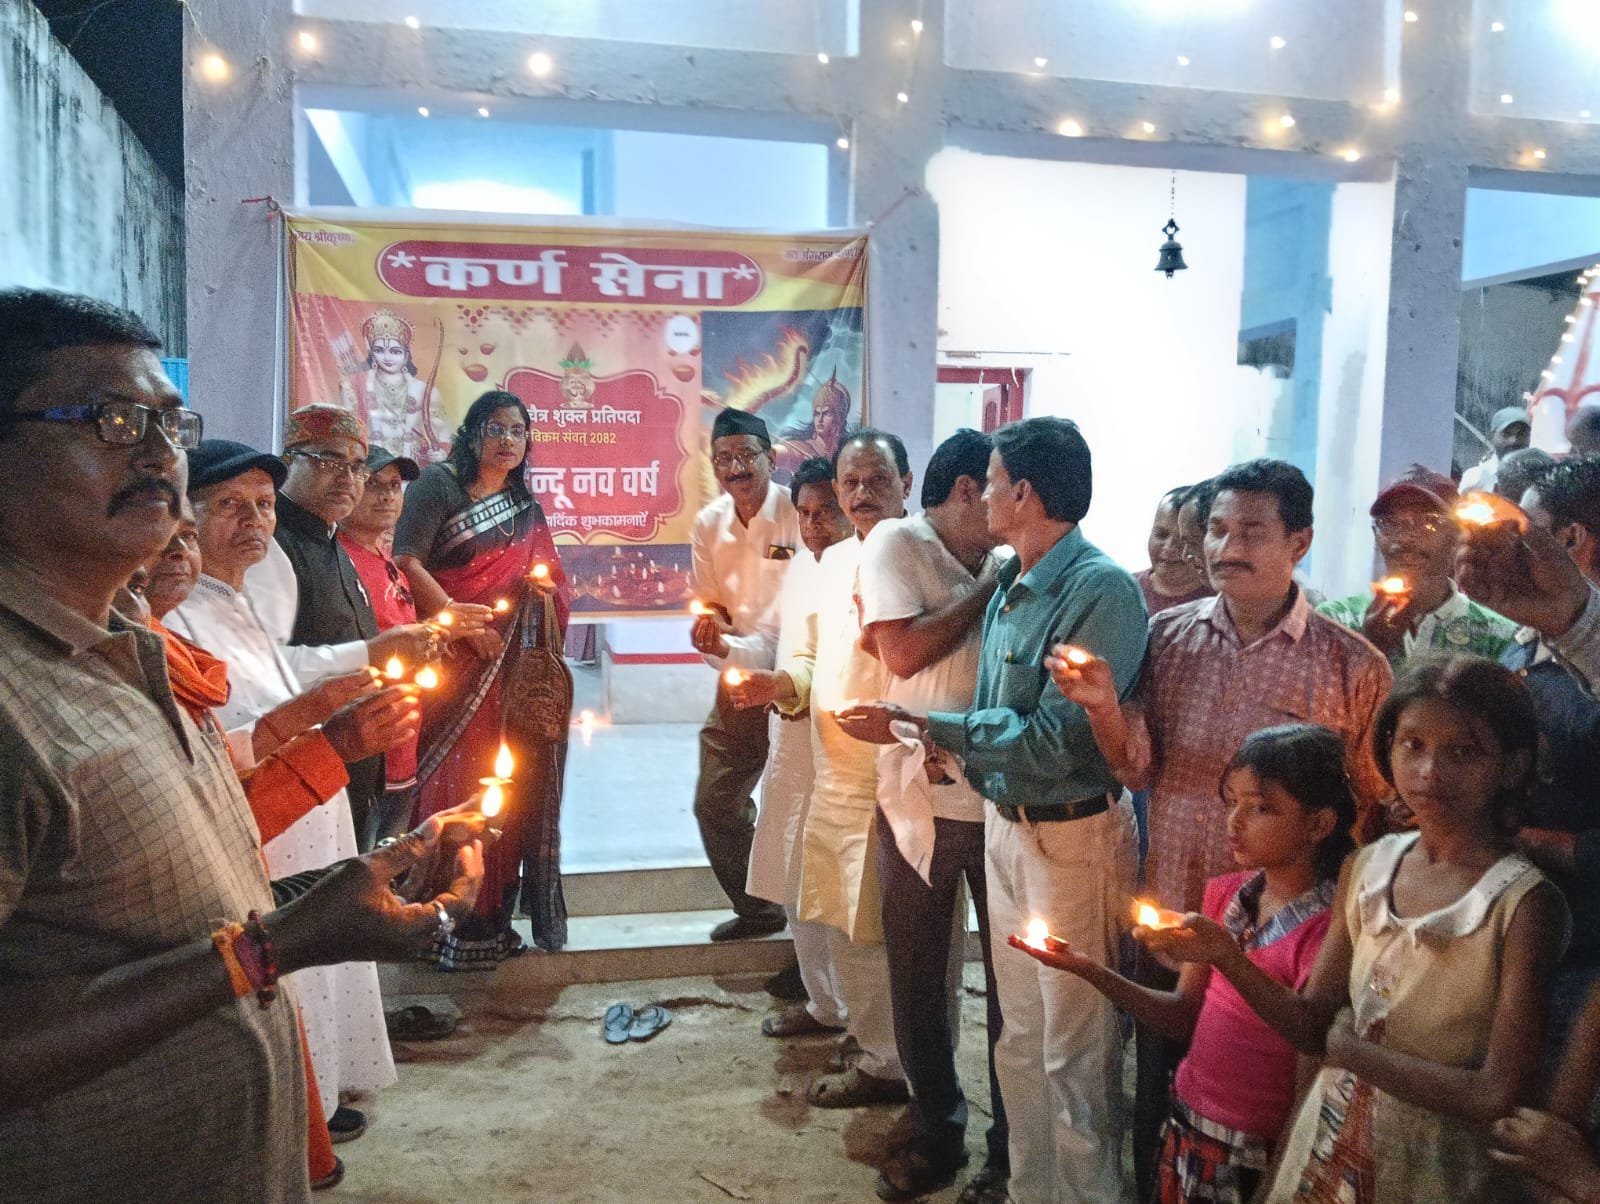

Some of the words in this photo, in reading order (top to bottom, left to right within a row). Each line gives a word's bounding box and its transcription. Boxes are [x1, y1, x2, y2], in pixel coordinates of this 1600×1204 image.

[553, 408, 588, 427] शुक्ल
[591, 405, 641, 424] प्रतिपदा
[531, 429, 560, 443] विक्रम
[589, 432, 617, 444] 2082
[571, 467, 617, 497] नव
[620, 460, 660, 497] वर्ष
